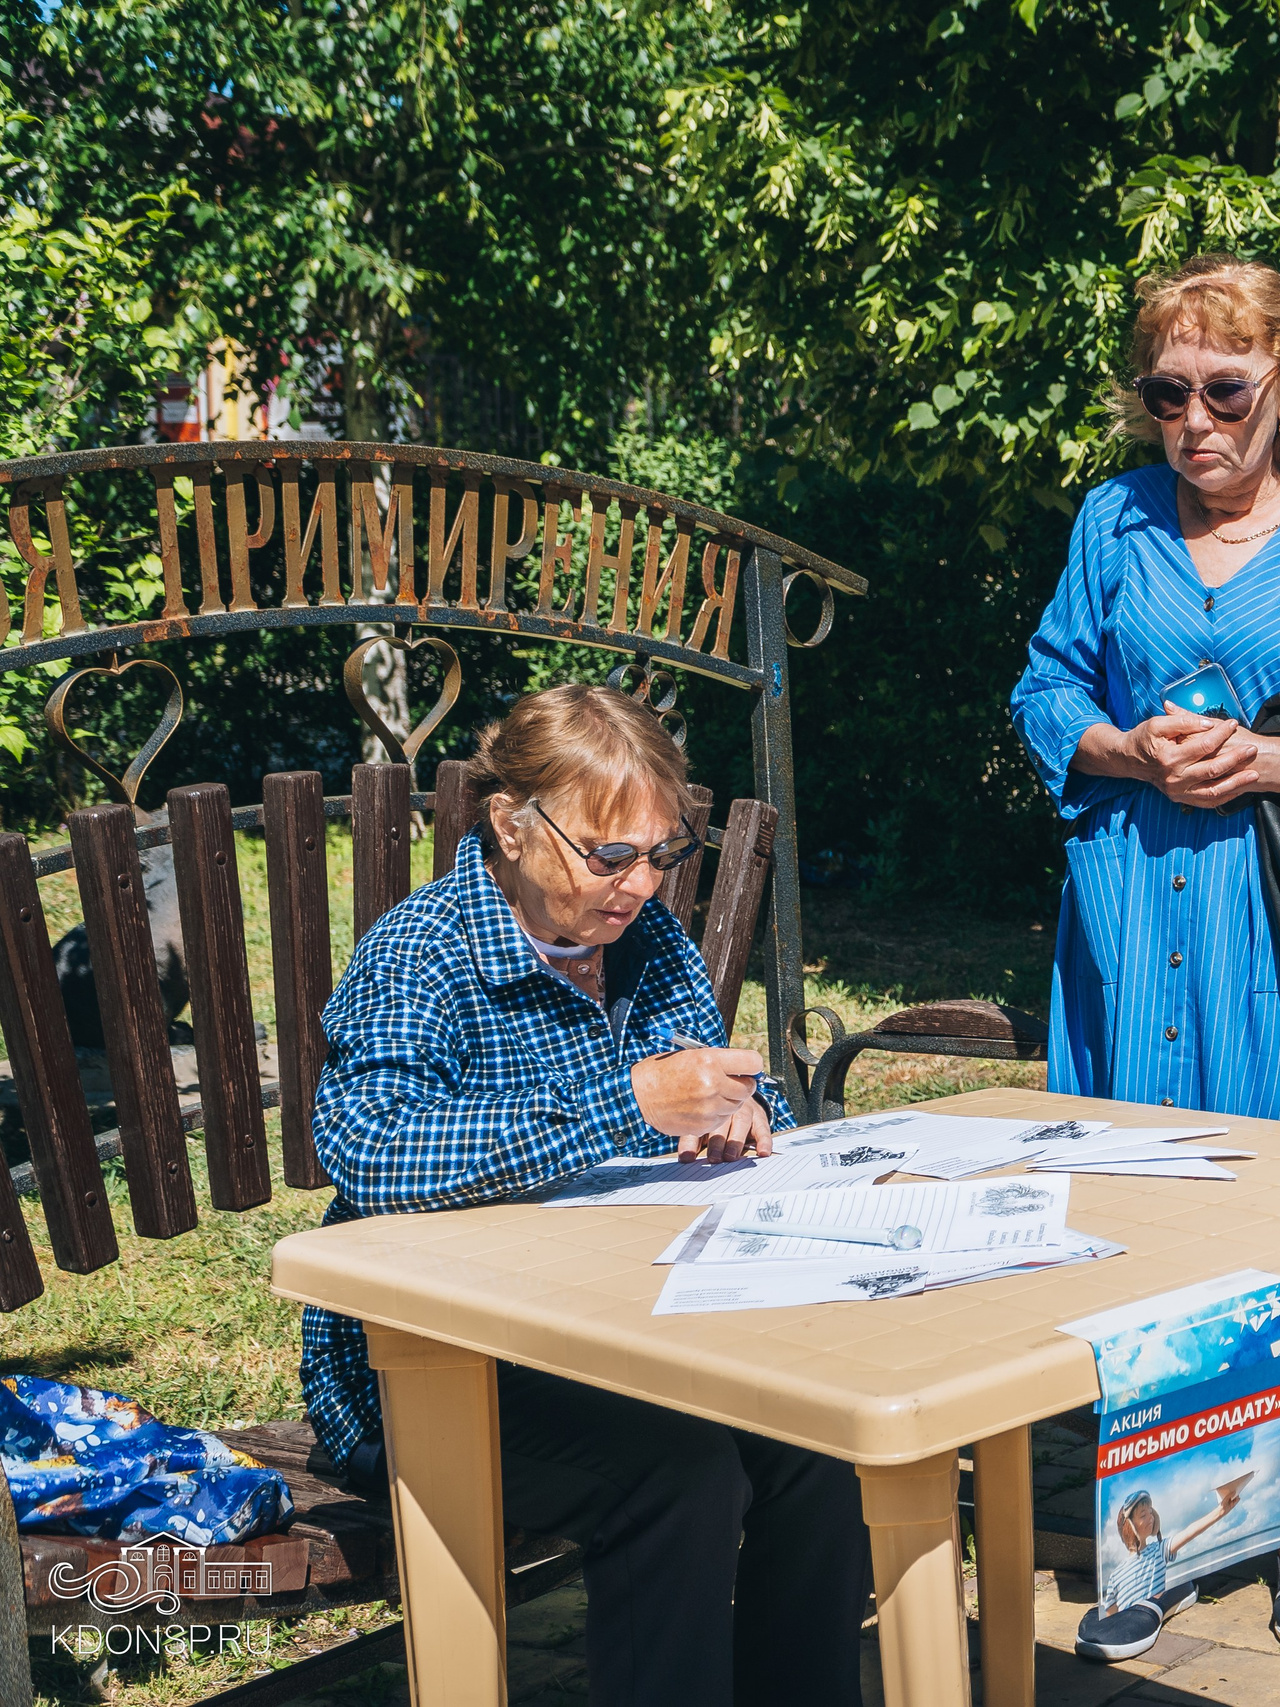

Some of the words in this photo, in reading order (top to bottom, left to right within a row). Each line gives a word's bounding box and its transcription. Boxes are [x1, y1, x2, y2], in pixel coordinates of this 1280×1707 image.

[0, 475, 89, 647] Я
[152, 459, 744, 662] ПРИМИРЕНИЯ
[1109, 1403, 1162, 1437] АКЦИЯ
[1099, 1425, 1190, 1470] «ПИСЬМО
